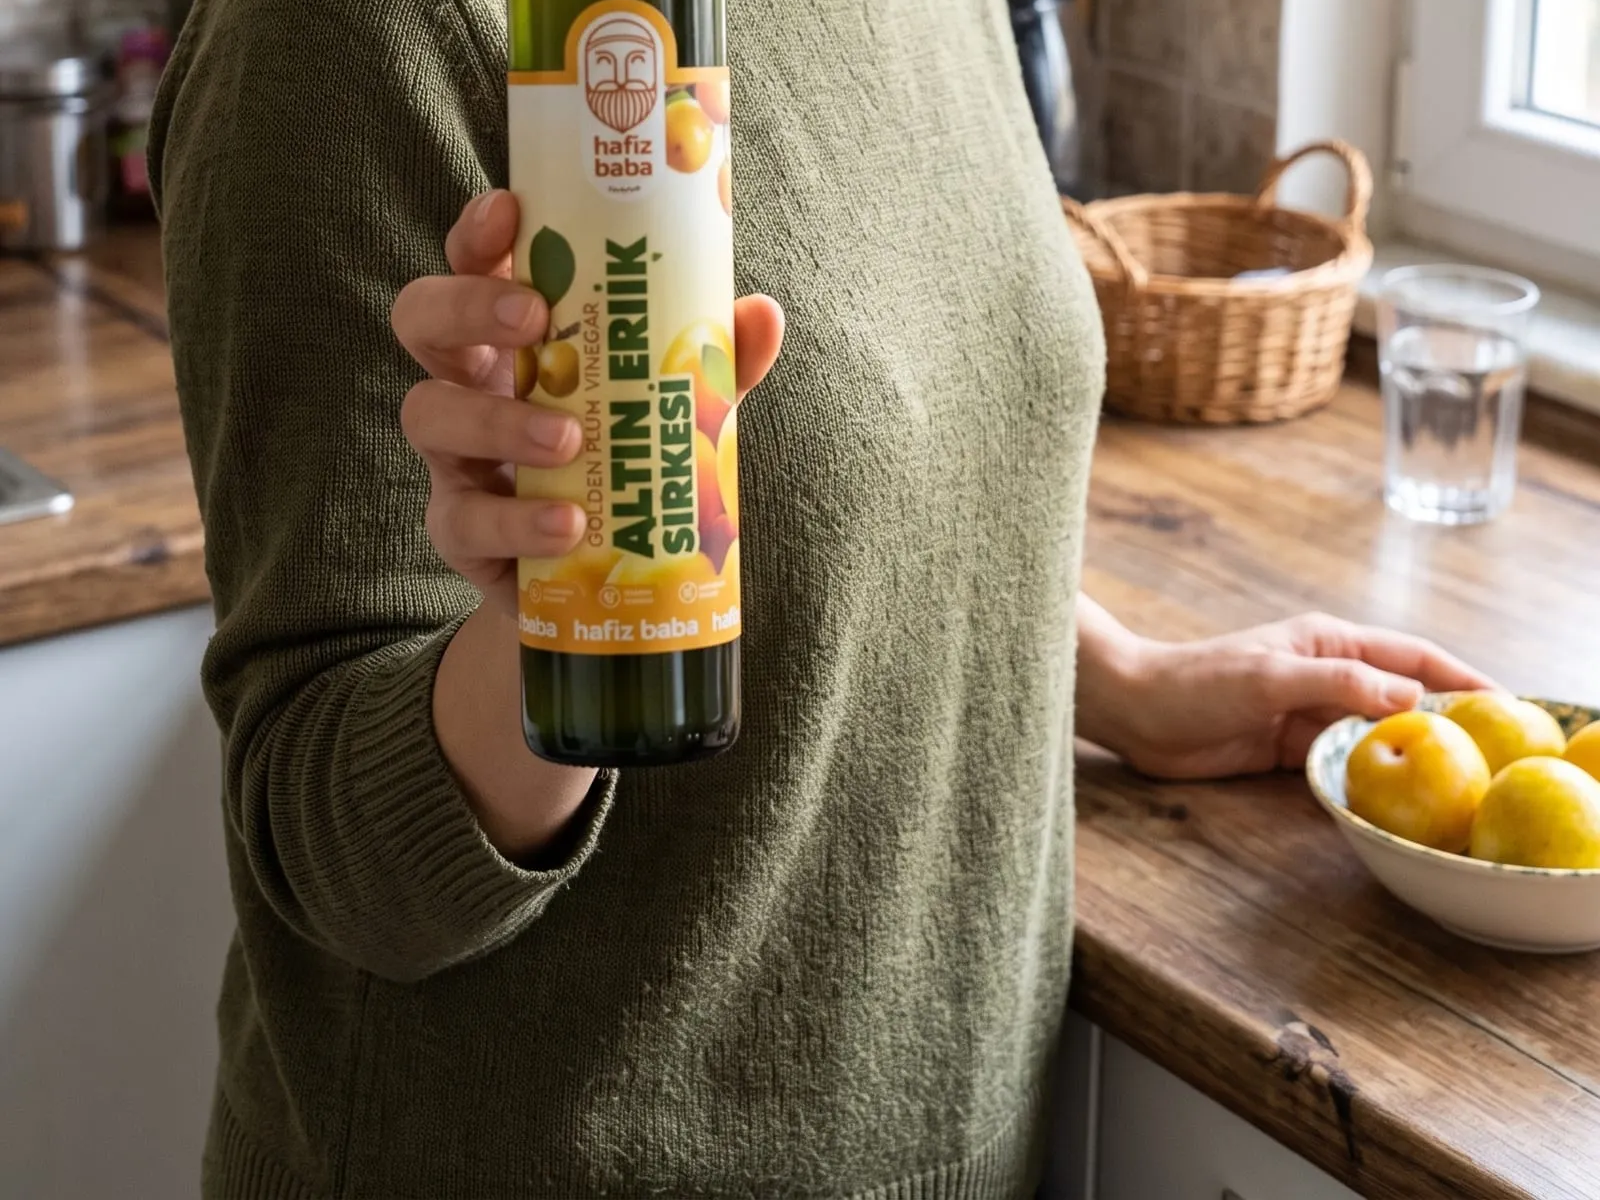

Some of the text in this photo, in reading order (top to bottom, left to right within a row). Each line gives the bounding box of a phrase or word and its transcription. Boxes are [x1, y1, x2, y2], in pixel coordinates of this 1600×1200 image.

[594, 157, 653, 178] baba
[583, 302, 604, 548] GOLDEN PLUM VINEGAR
[609, 400, 656, 560] ALTIN
[573, 615, 699, 641] hafiz baba
